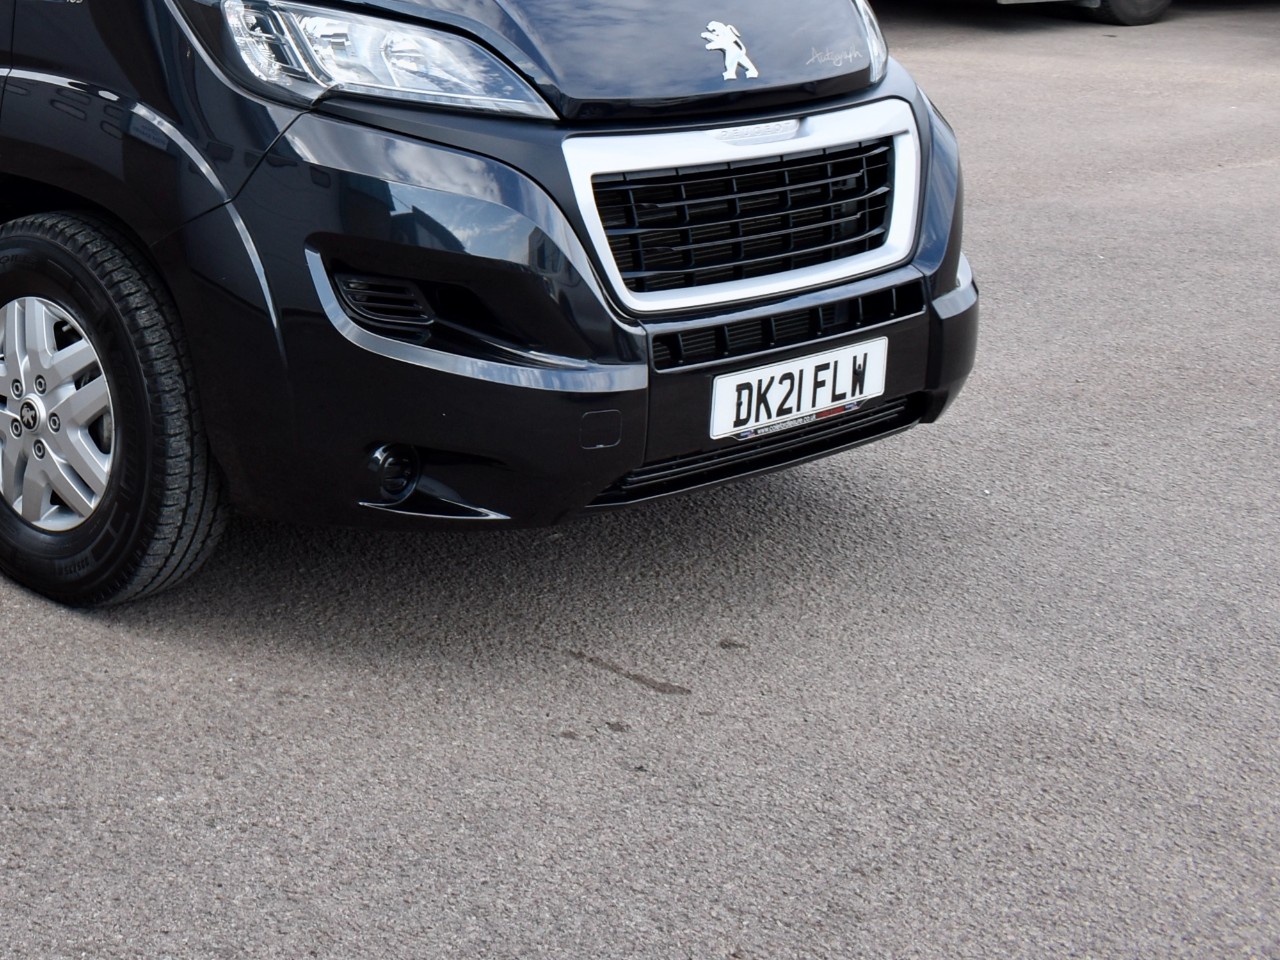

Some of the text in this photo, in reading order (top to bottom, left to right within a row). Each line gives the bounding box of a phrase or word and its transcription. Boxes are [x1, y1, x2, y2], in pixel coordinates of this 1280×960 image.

[721, 122, 791, 138] PEUGEOT
[733, 353, 868, 428] DK21 FLW
